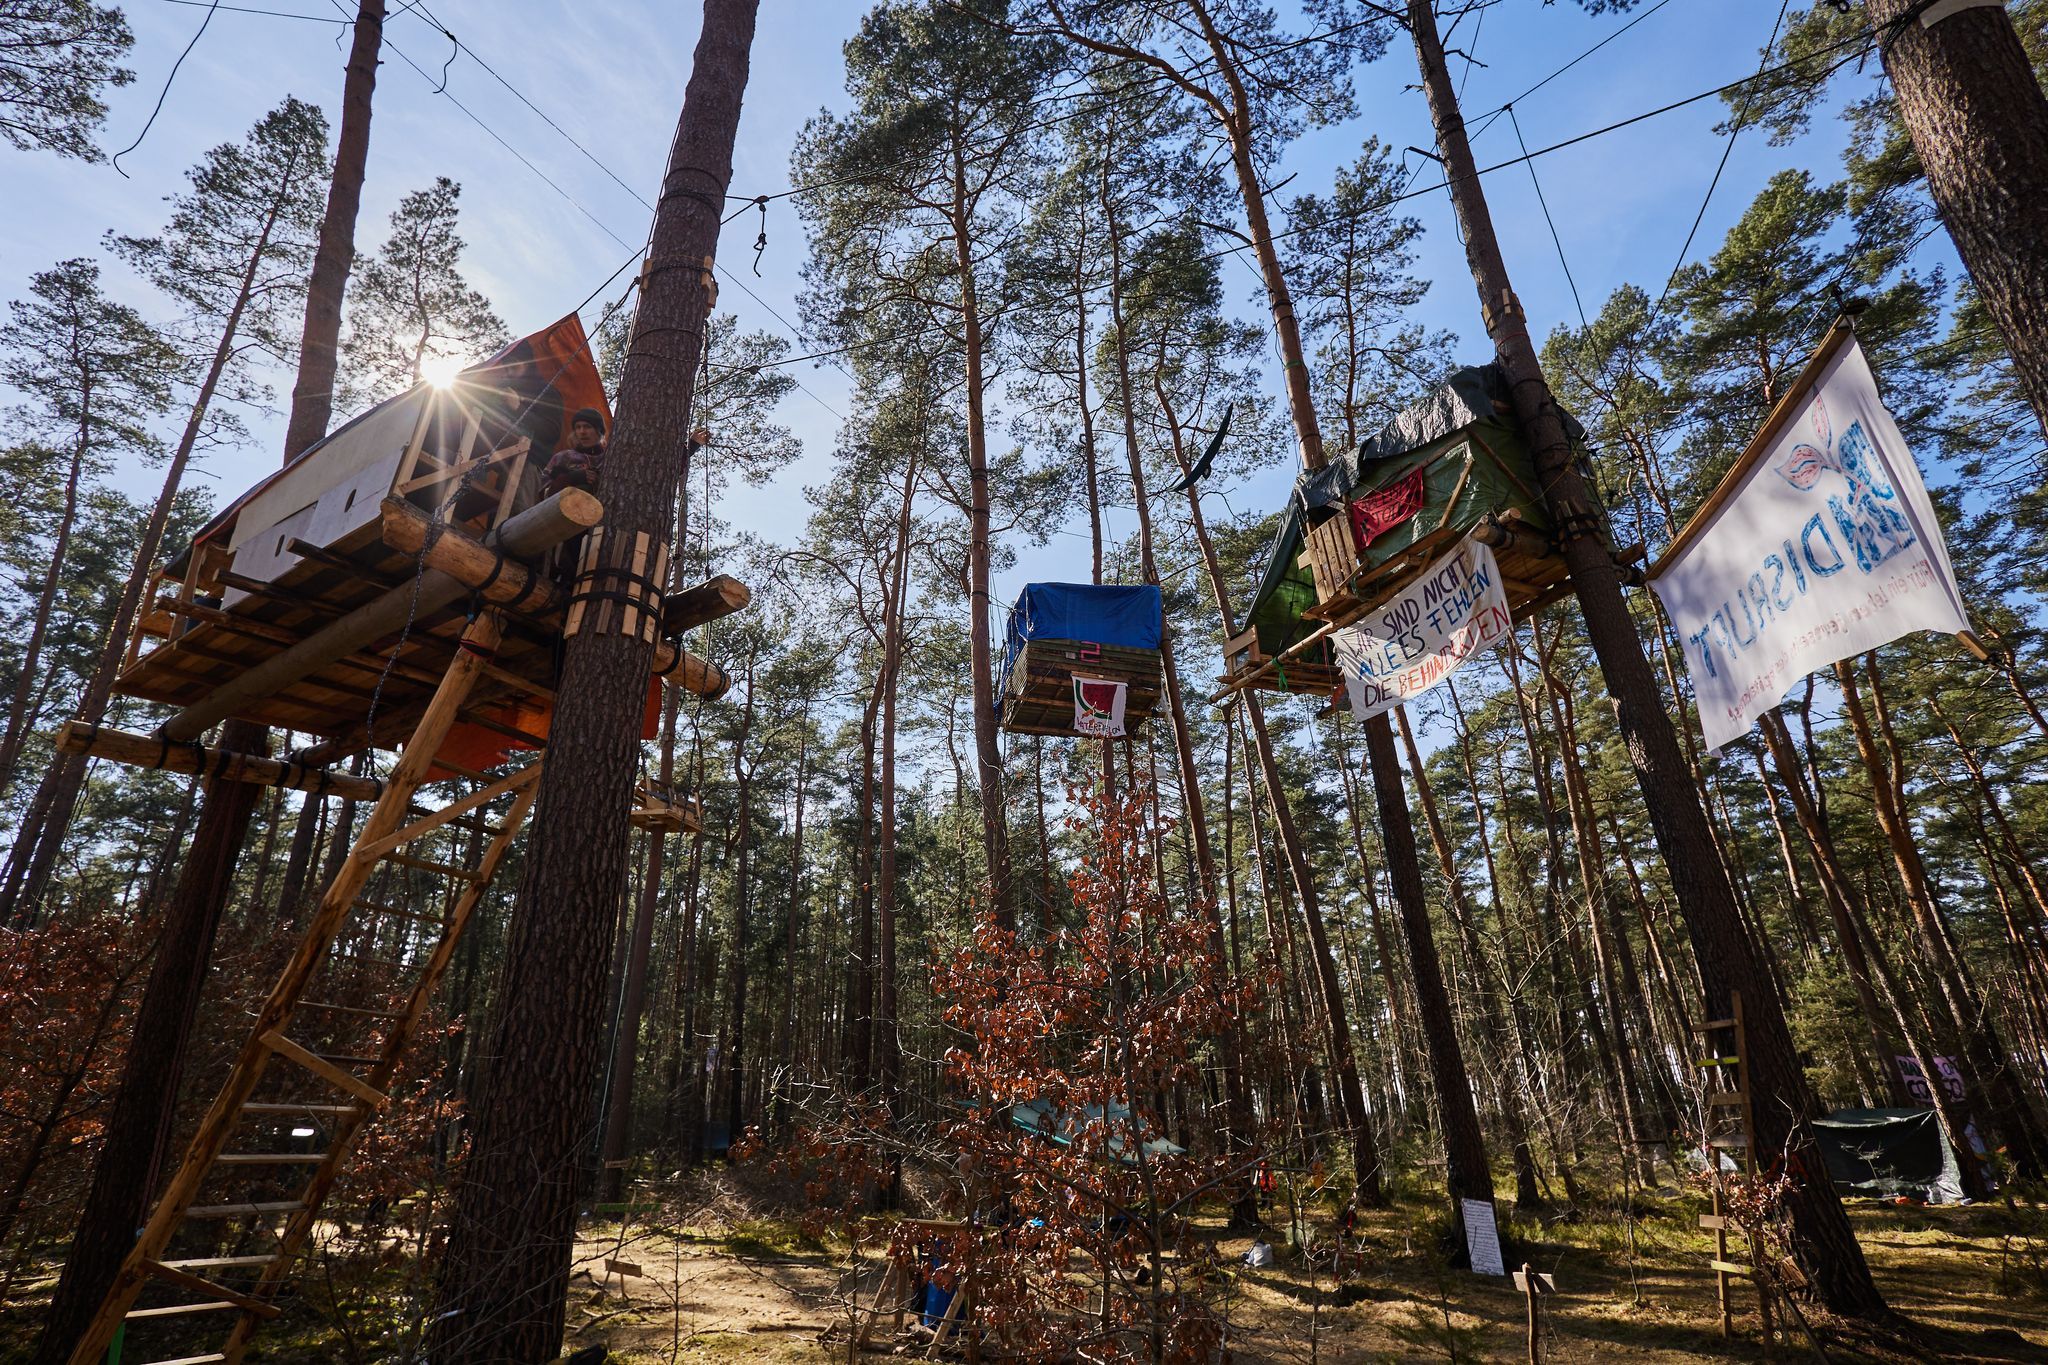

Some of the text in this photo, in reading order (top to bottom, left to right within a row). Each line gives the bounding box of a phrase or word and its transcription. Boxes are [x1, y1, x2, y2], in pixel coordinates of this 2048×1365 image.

[1341, 552, 1469, 658] WIR SIND NICHT
[1426, 563, 1491, 635] FEHLEN
[1365, 677, 1393, 708] DIE
